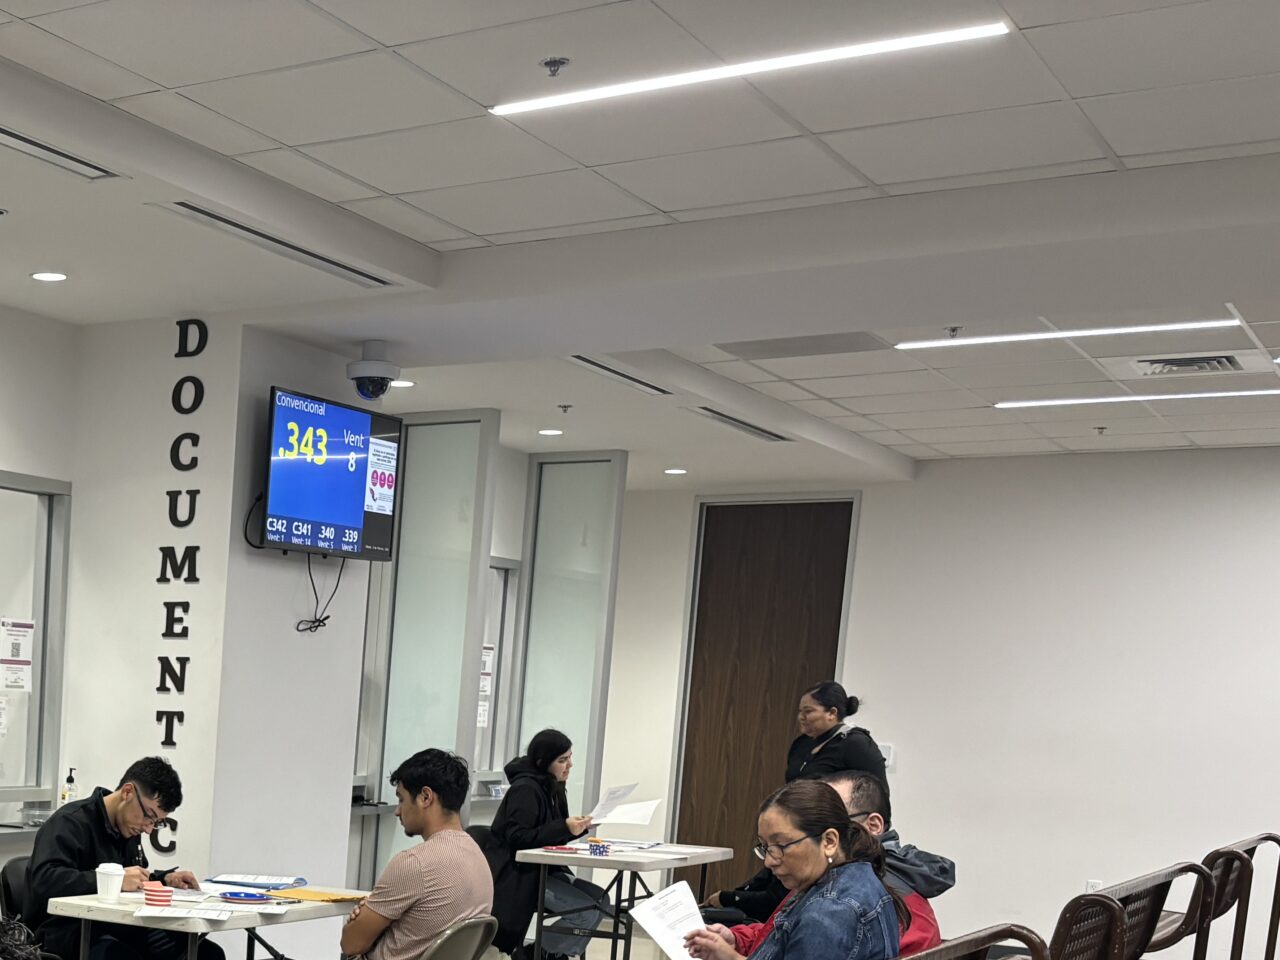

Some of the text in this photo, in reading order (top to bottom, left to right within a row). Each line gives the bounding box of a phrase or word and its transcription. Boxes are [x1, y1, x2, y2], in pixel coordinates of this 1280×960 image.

[275, 391, 326, 416] Convencional
[343, 428, 364, 448] Vent
[348, 451, 356, 472] 8
[266, 517, 287, 533] C342
[292, 521, 312, 536] C341
